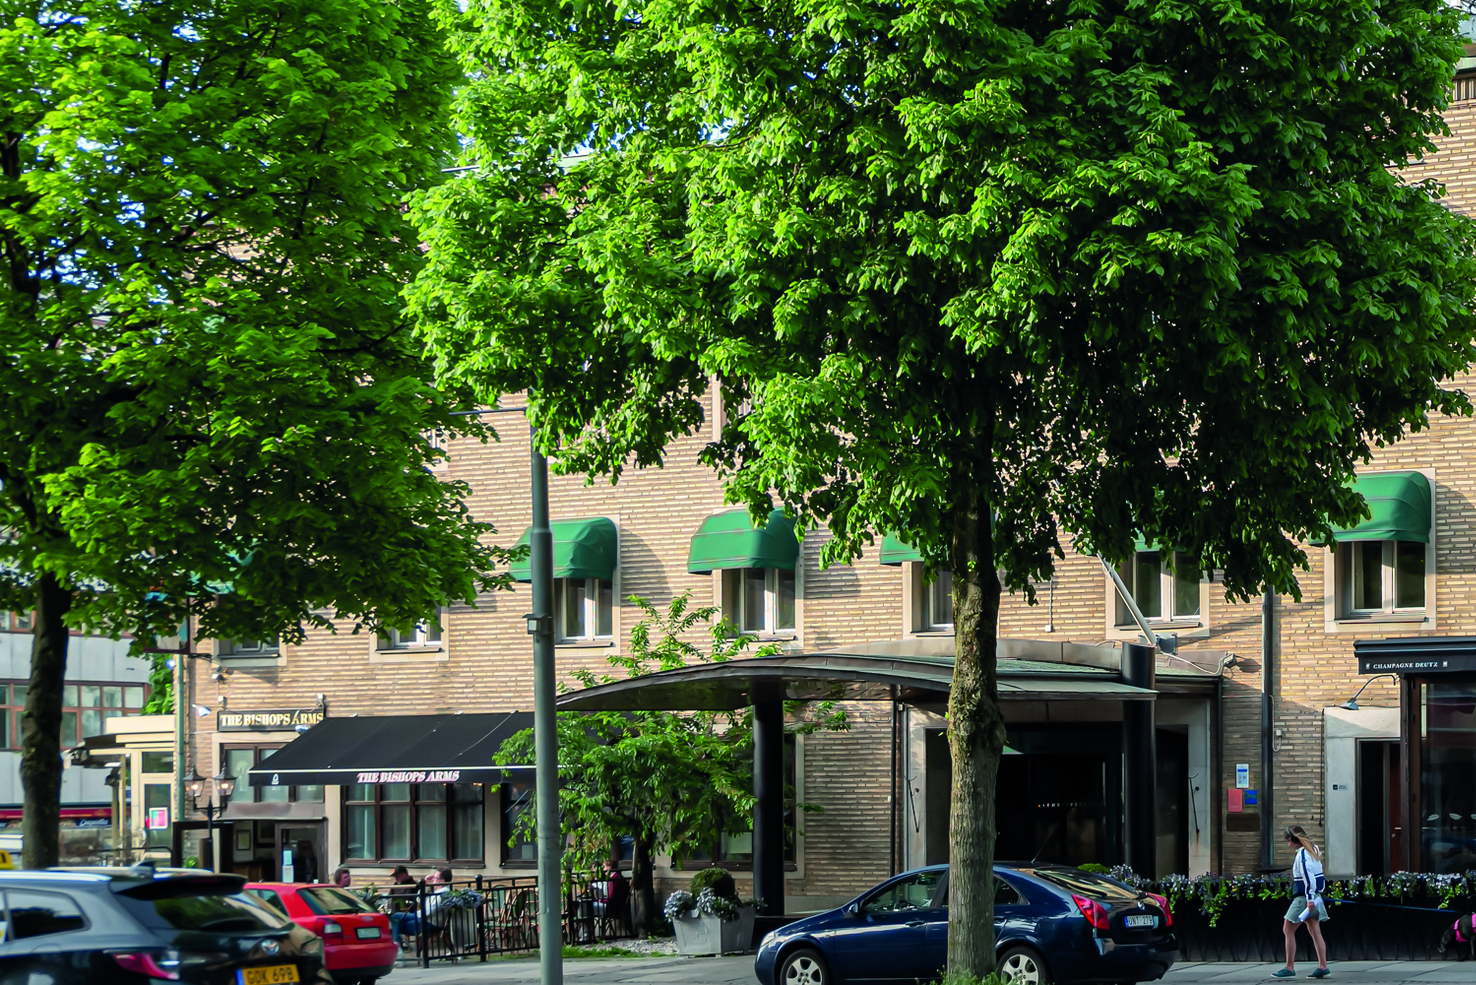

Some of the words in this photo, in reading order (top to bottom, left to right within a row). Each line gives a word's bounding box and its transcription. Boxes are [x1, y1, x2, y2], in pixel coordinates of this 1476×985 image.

[220, 714, 243, 726] THE
[243, 713, 291, 726] BISHOPS
[291, 712, 323, 725] ARMS
[356, 772, 379, 783] THE
[379, 771, 425, 783] BISHOPS
[425, 770, 460, 782] ARMS
